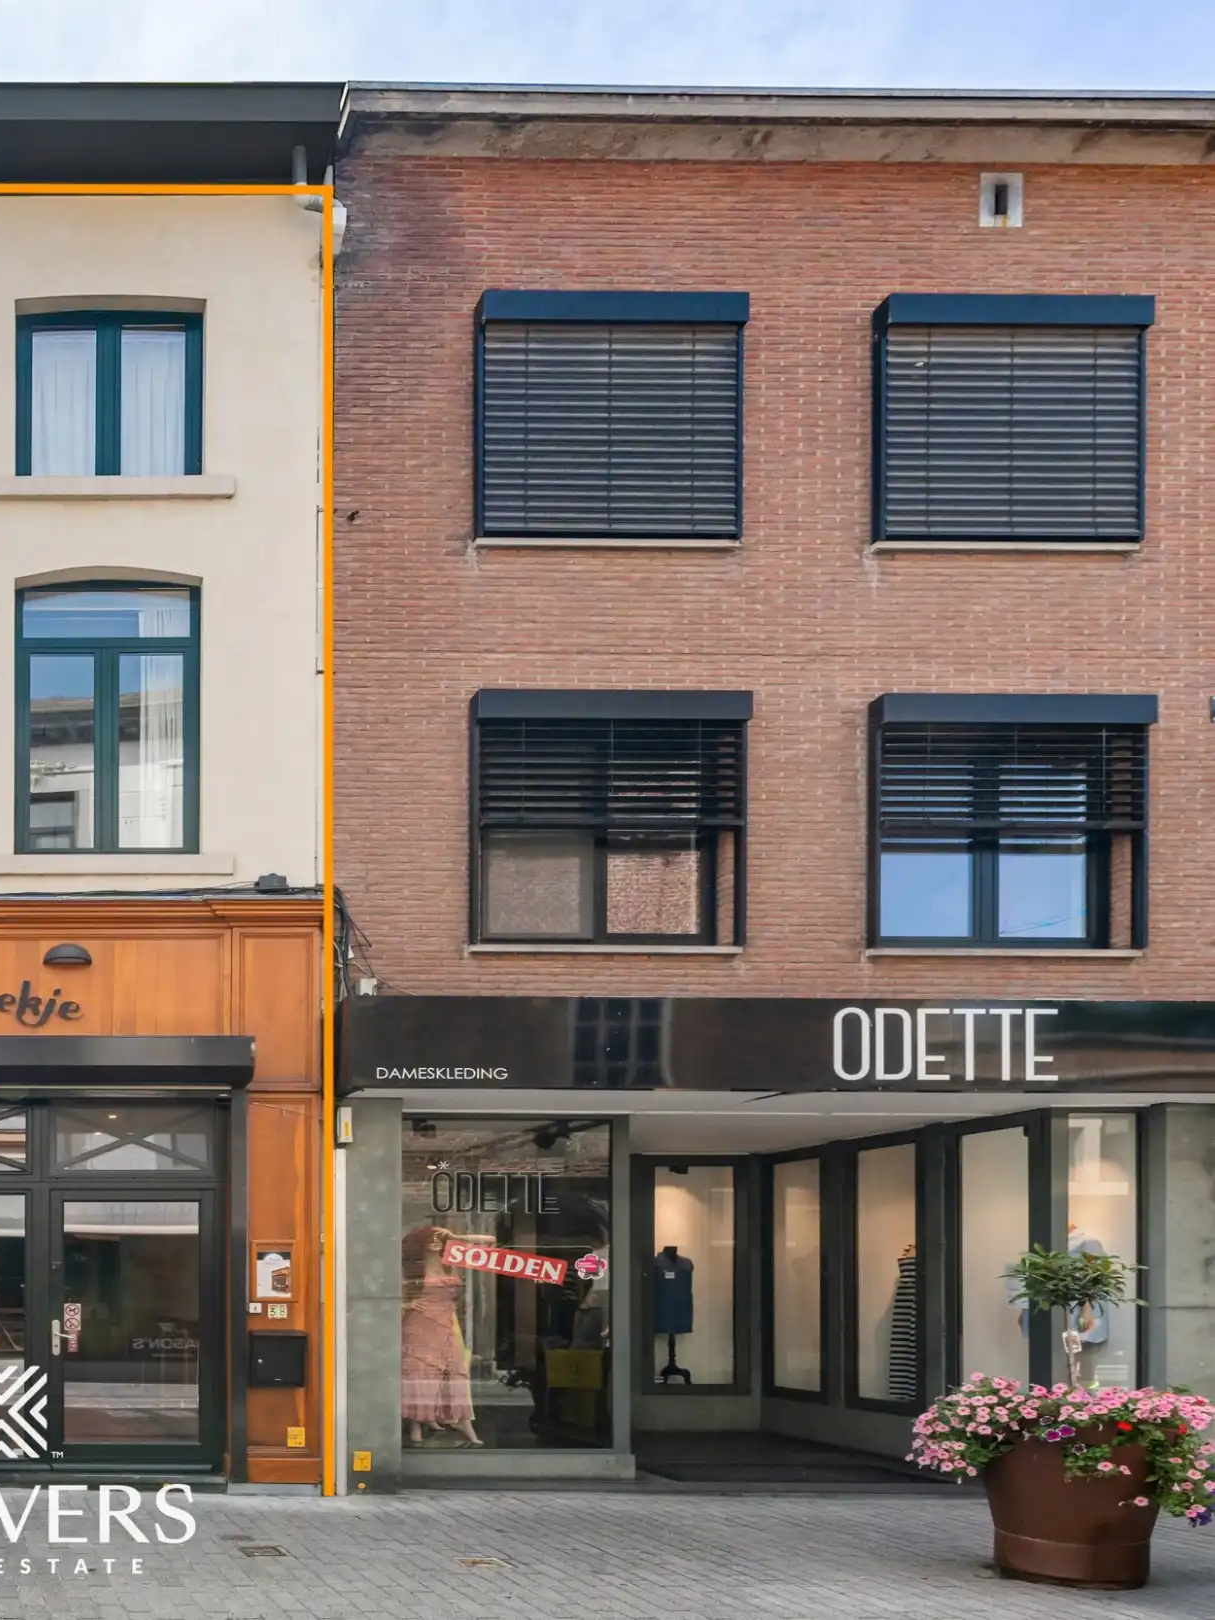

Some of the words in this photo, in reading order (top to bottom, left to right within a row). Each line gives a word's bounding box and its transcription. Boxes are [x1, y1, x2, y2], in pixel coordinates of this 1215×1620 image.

[833, 1007, 1059, 1081] ODETTE
[376, 1067, 508, 1080] DAMESKLEDING
[431, 1171, 561, 1214] ODETTE
[448, 1245, 562, 1281] SOLDEN
[269, 1307, 285, 1317] 38
